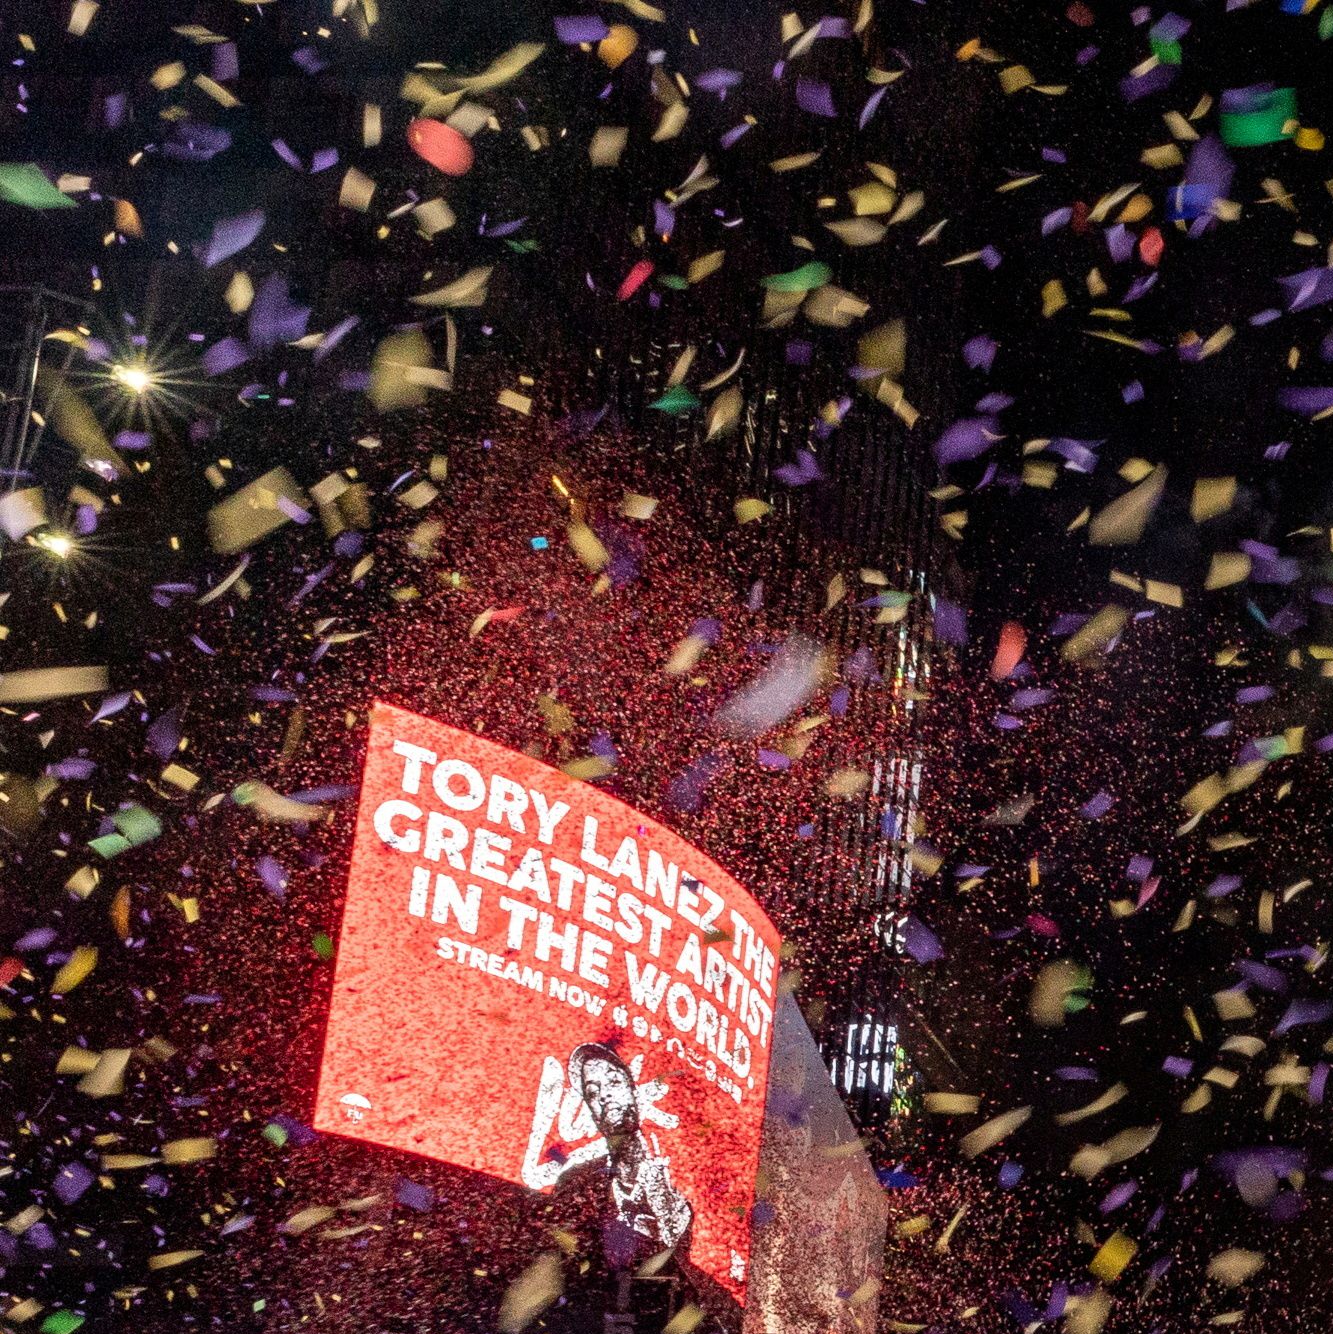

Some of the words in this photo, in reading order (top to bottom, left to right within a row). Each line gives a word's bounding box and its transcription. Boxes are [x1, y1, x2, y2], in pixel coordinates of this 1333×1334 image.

[373, 800, 672, 957] GREATEST
[676, 933, 773, 1047] ARTIST
[393, 740, 570, 845] TORY
[580, 816, 725, 933] LANEZ
[730, 911, 776, 997] THE
[408, 866, 482, 934] IN
[500, 897, 613, 988] THE
[624, 950, 756, 1090] WORLD.
[437, 937, 544, 992] STREAM
[548, 976, 608, 1016] NOW
